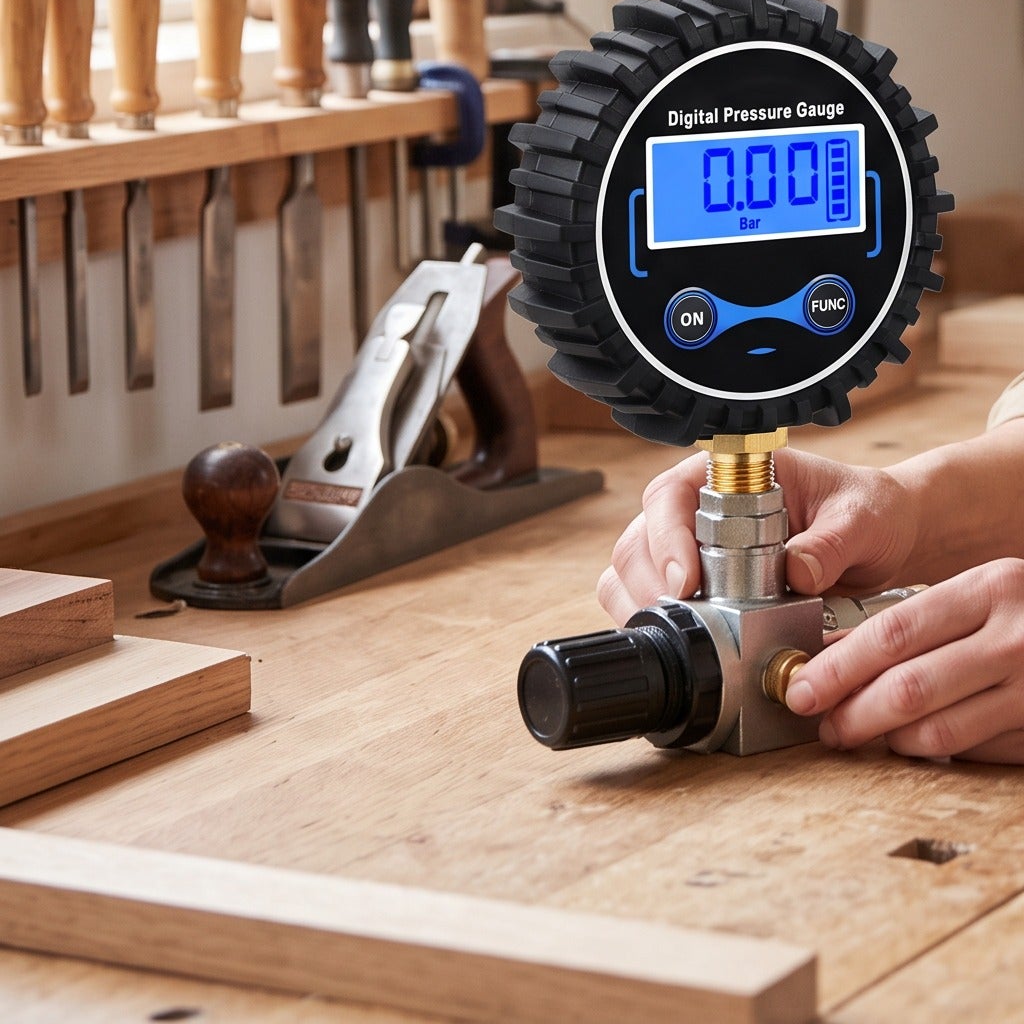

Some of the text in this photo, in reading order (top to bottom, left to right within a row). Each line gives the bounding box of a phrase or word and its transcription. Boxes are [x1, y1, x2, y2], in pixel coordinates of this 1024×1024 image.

[668, 101, 846, 130] Digital Pressure Gauge
[703, 141, 819, 213] 0.00
[739, 216, 762, 231] Bar
[811, 297, 846, 313] FUNC
[680, 311, 704, 327] ON
